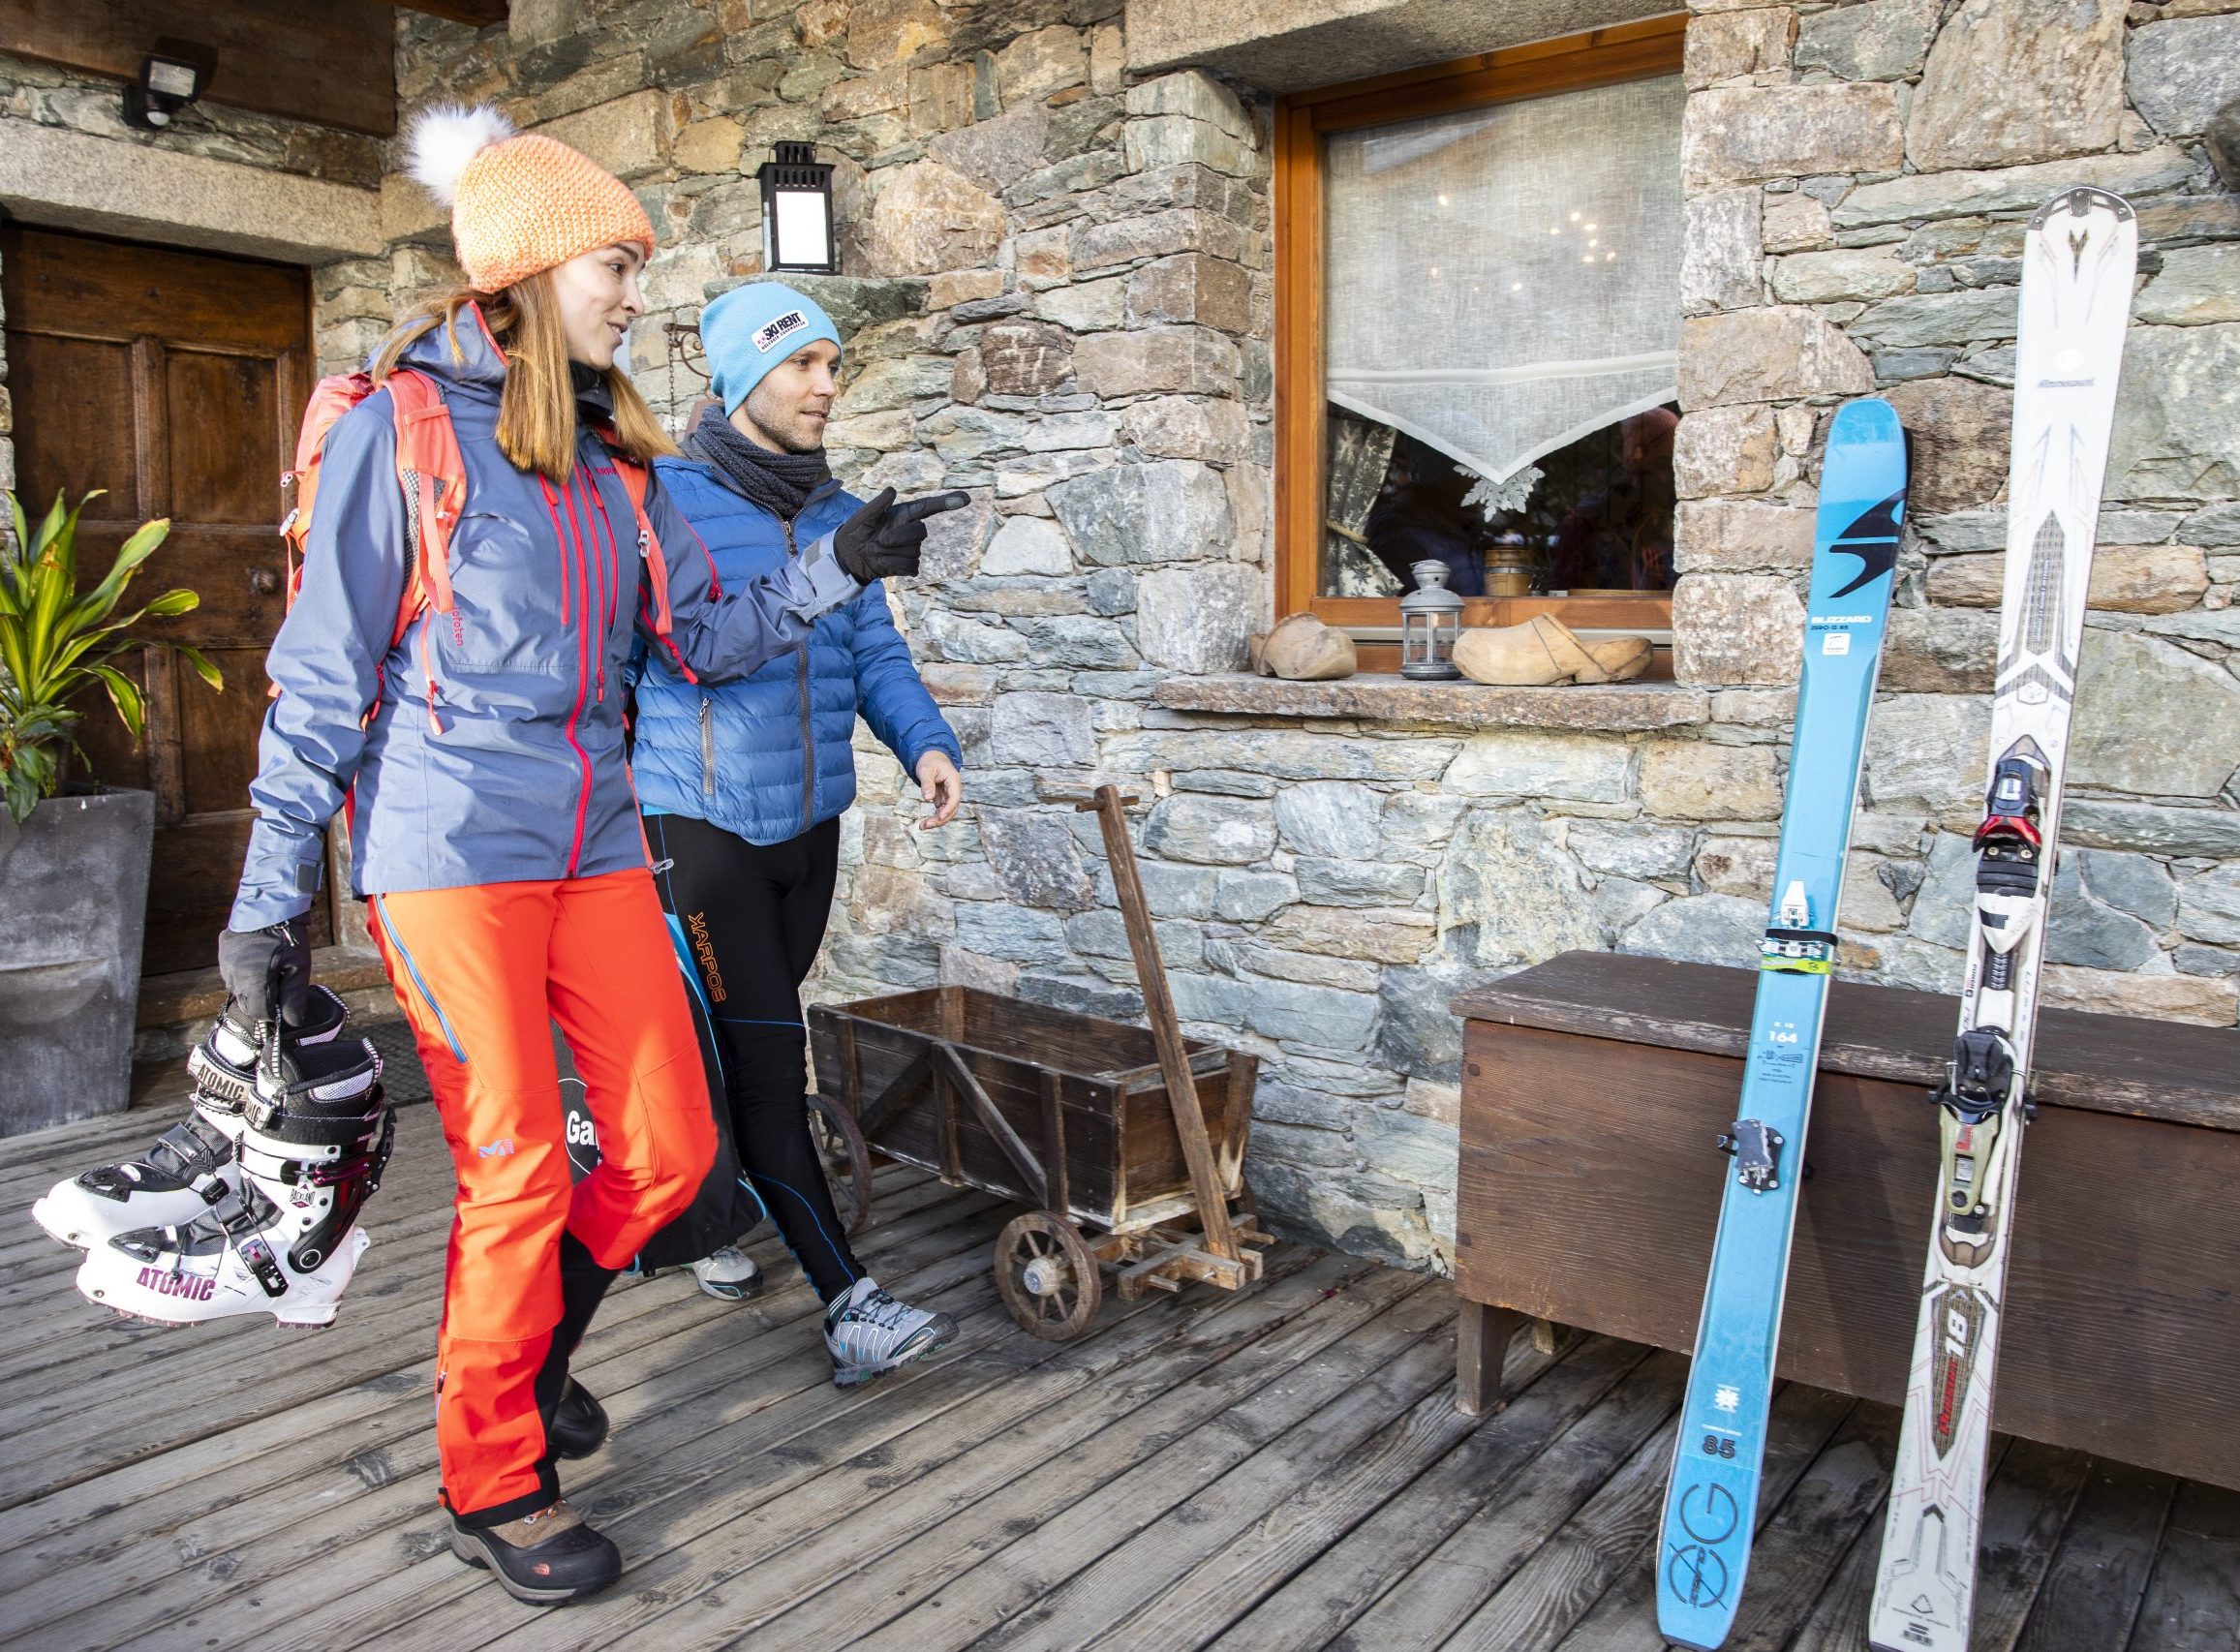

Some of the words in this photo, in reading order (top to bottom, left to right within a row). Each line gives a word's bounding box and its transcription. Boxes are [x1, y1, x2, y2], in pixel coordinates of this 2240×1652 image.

[762, 323, 780, 341] SKI
[776, 312, 802, 330] RENT
[451, 606, 464, 647] lofoten
[1811, 616, 1872, 625] BLIZZARD
[688, 911, 727, 1002] KARPOS
[1768, 1030, 1798, 1044] 164
[197, 1063, 245, 1100] ATOMIC
[136, 1267, 216, 1301] ATOMIC
[1946, 1308, 1968, 1359] 18
[1702, 1435, 1735, 1459] 85
